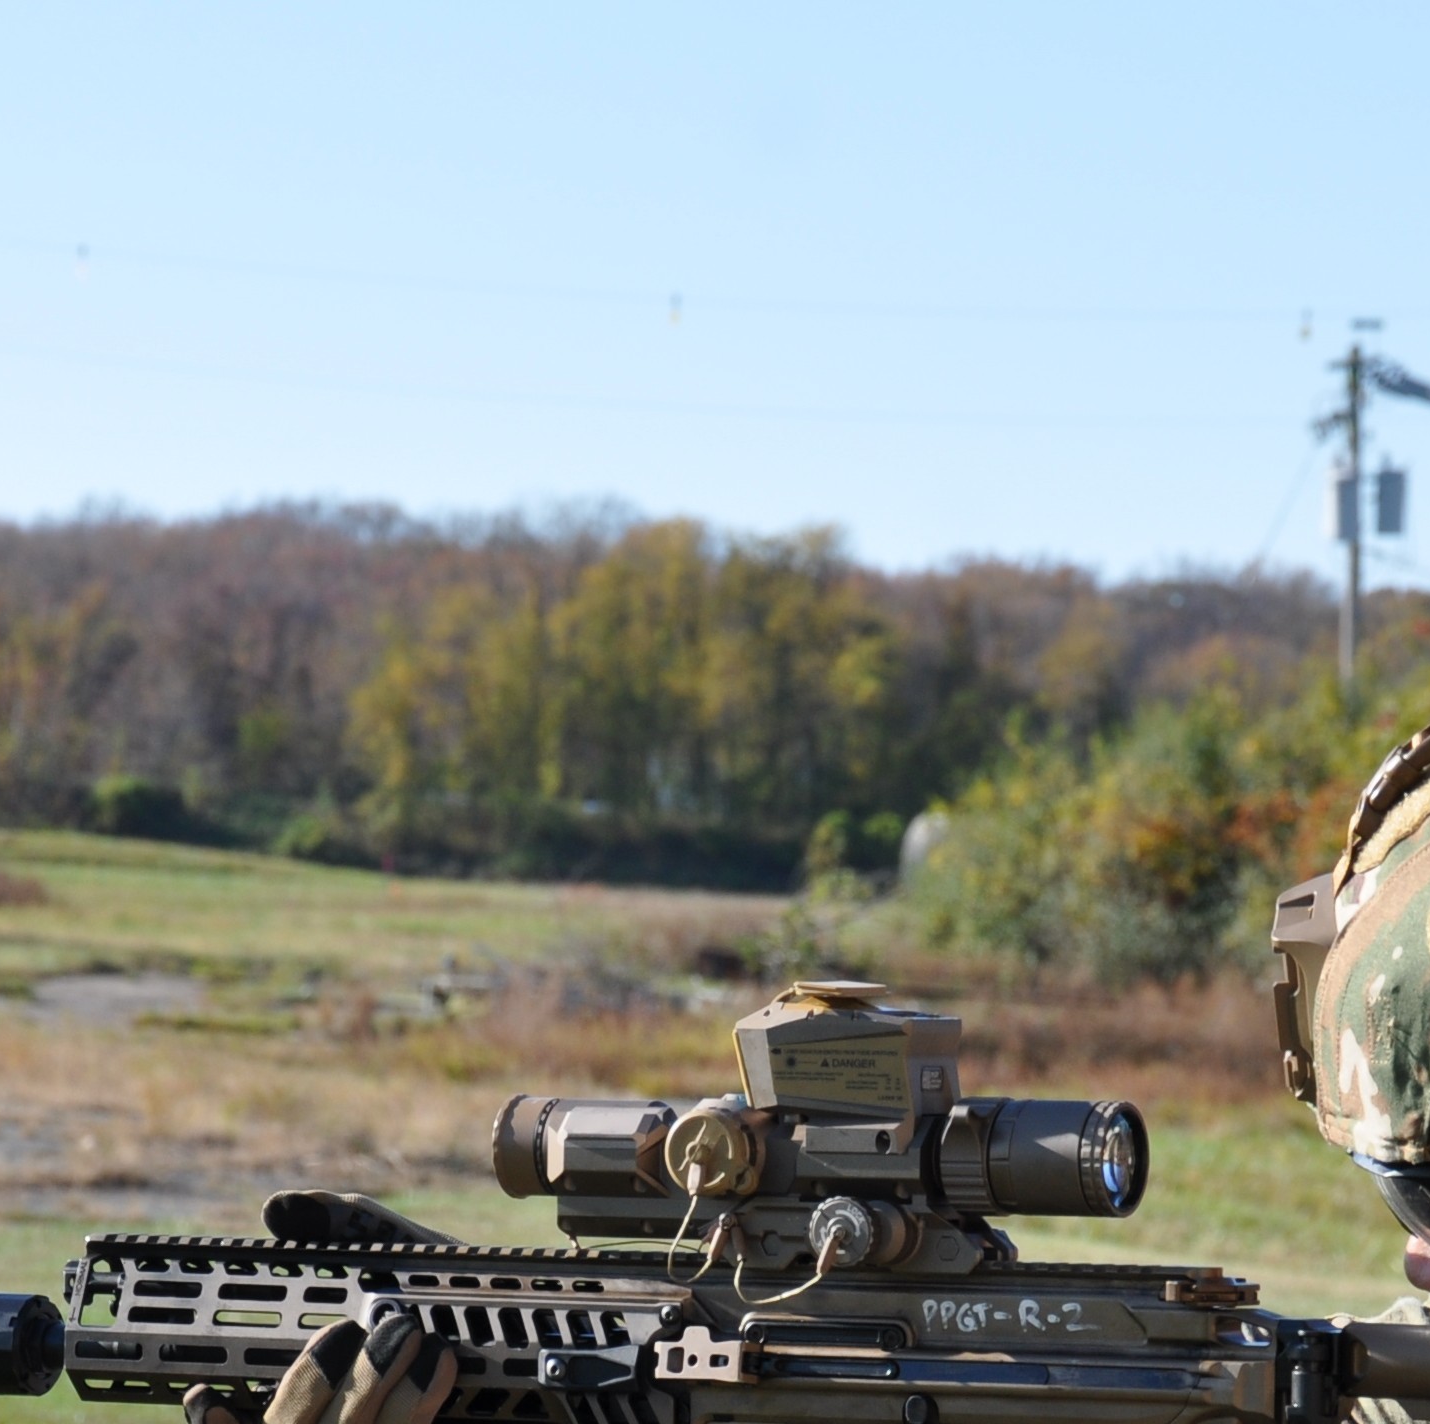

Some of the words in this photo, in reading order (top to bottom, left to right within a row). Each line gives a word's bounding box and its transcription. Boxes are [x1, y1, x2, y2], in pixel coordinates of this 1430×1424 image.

[832, 1058, 876, 1068] DANGER
[847, 1203, 866, 1225] LOCK
[74, 1262, 87, 1296] NORMAL
